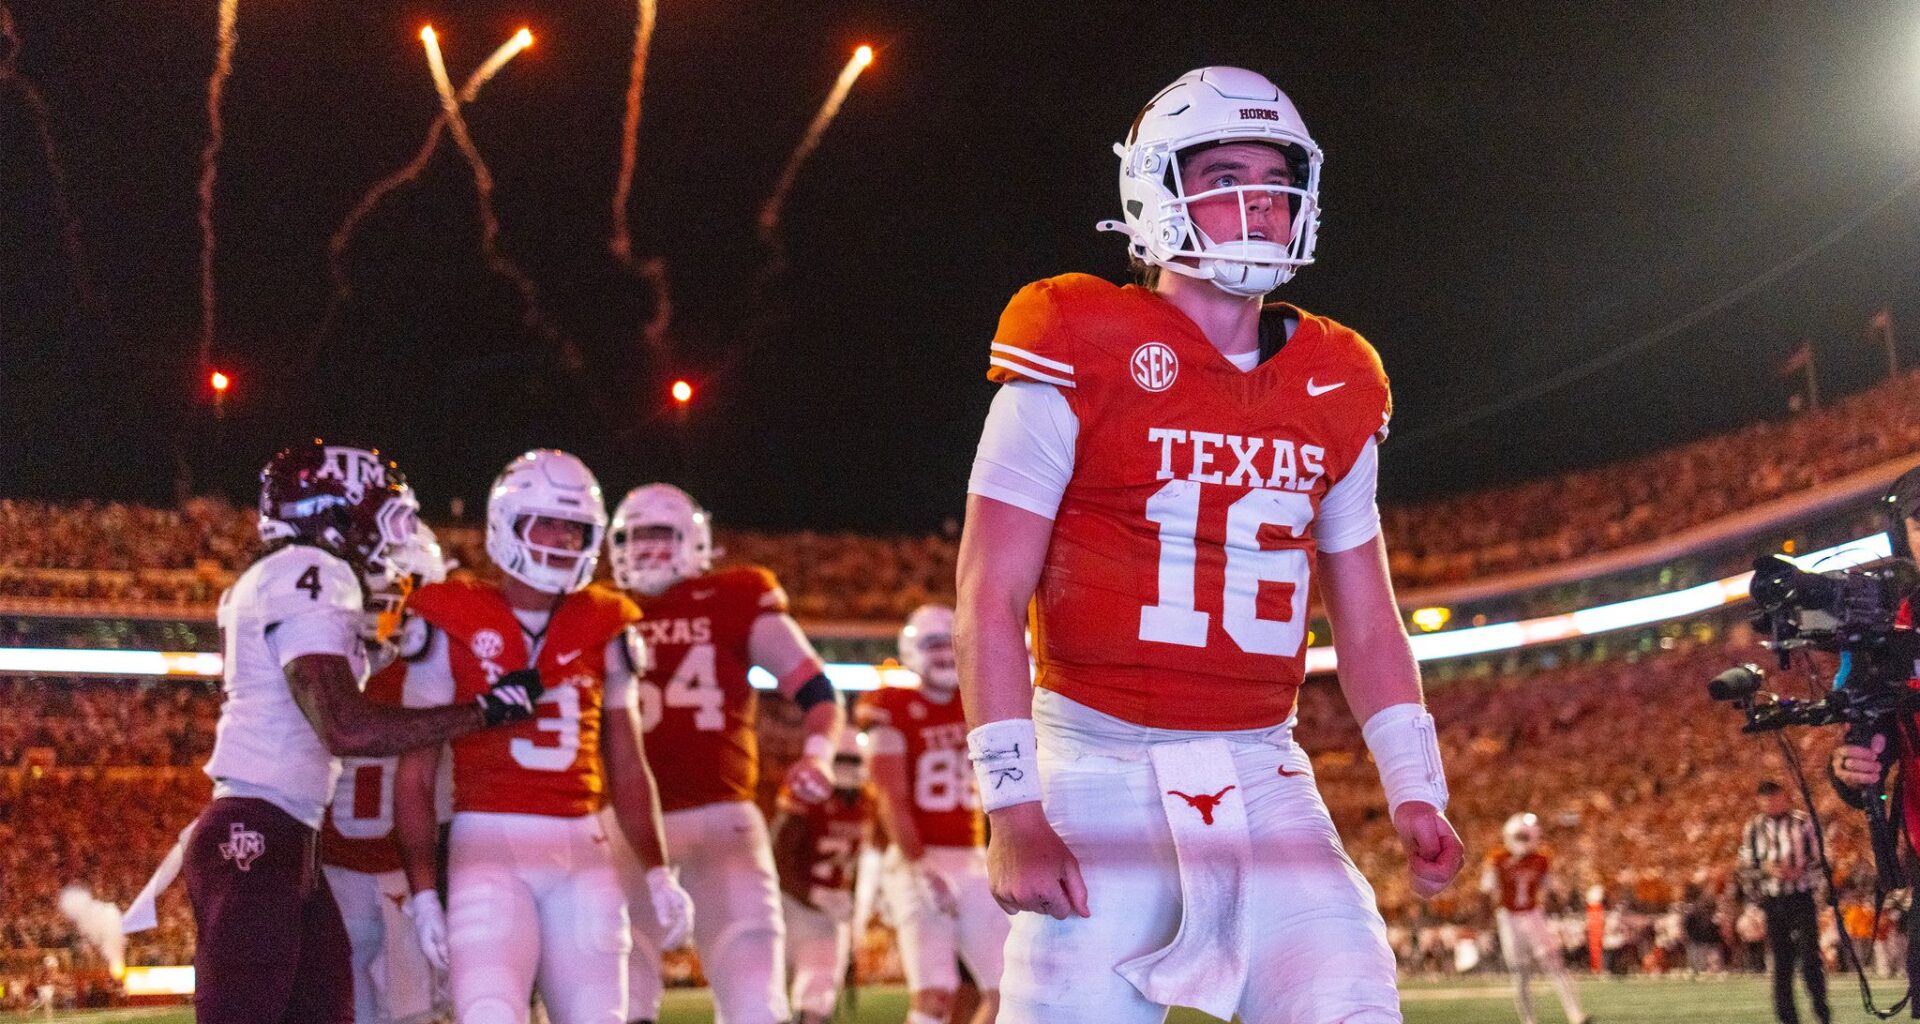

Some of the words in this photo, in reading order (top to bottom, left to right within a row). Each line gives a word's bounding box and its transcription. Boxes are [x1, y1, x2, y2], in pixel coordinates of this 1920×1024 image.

[1239, 108, 1280, 121] HORNS
[1134, 346, 1174, 388] SEC
[1148, 427, 1325, 491] TEXAS
[295, 565, 323, 601] 4
[1138, 479, 1317, 657] 16
[510, 682, 581, 772] 3
